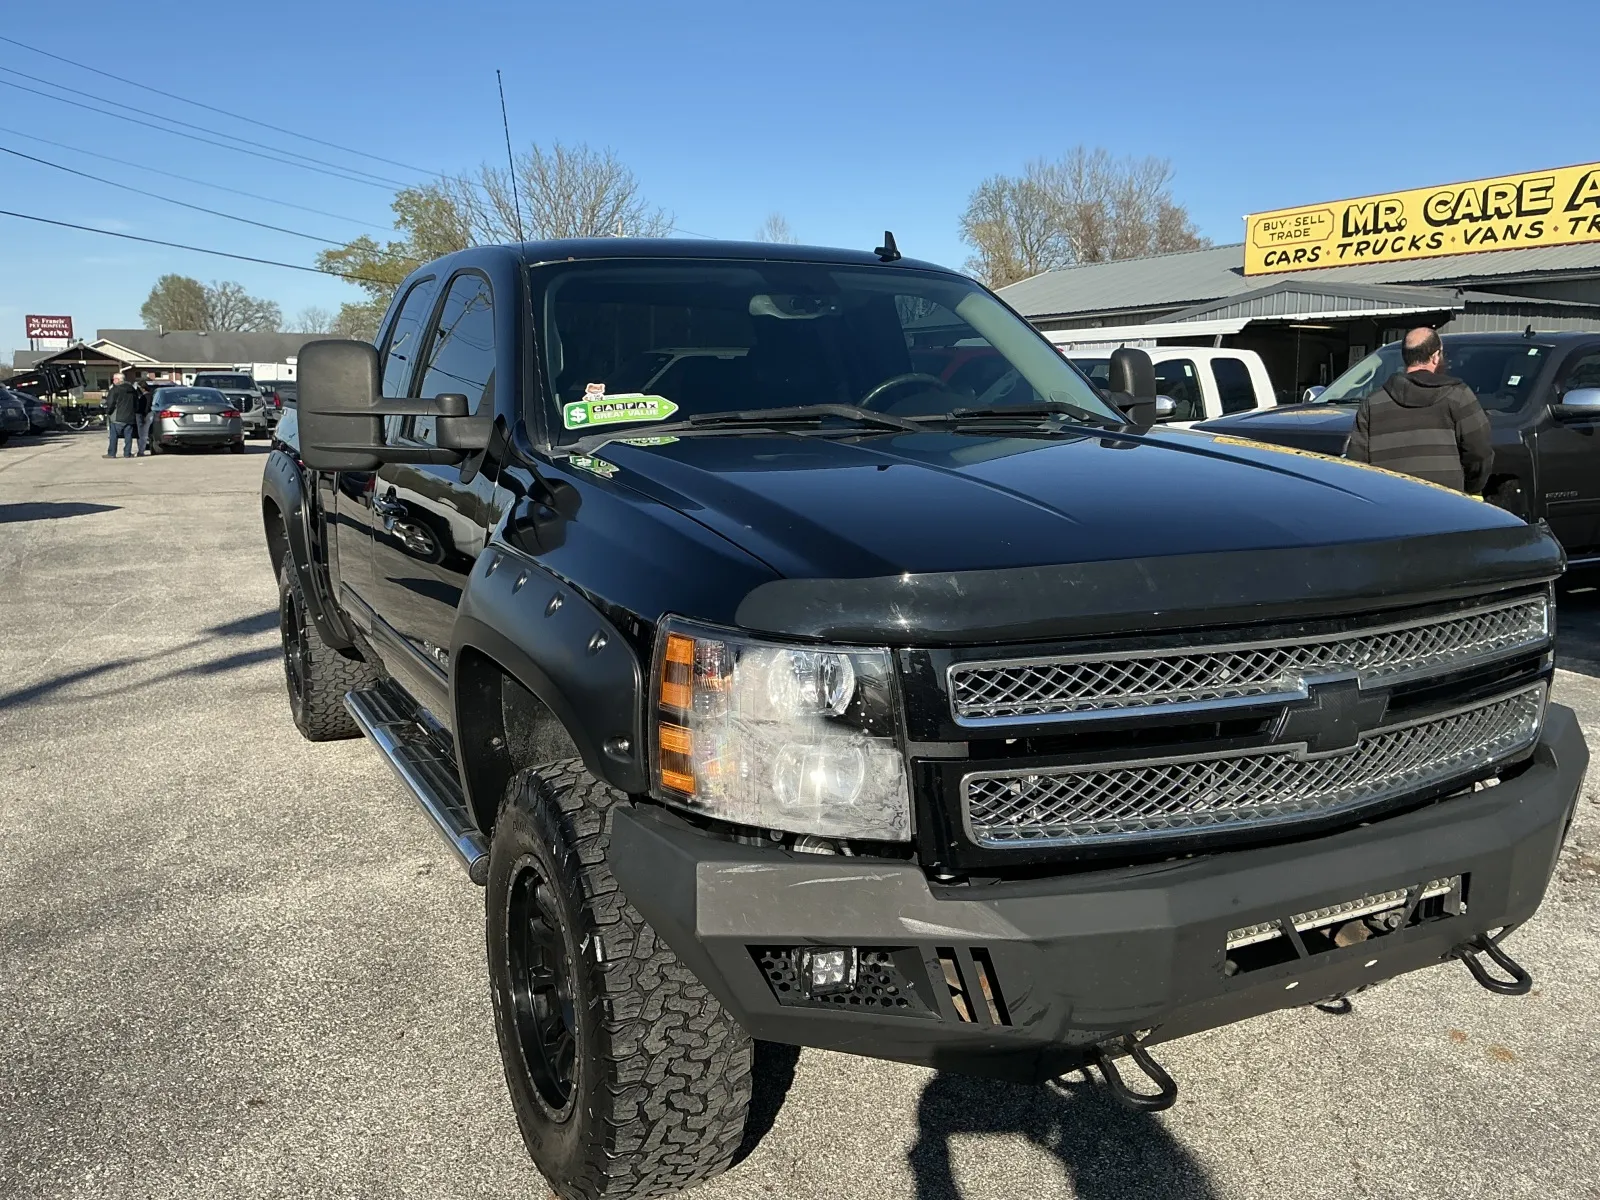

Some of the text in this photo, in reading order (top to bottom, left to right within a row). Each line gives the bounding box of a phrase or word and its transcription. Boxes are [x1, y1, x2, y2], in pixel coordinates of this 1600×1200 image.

[1342, 199, 1407, 239] MR.
[1423, 176, 1555, 228] CARE
[1263, 214, 1325, 231] BUY SELL
[1269, 227, 1311, 242] TRADE
[1263, 245, 1322, 267] CARS
[1336, 231, 1444, 260] TRUCKS
[1463, 220, 1545, 246] VANS
[593, 402, 658, 412] CARFAX
[593, 408, 659, 420] GREAT VALUE
